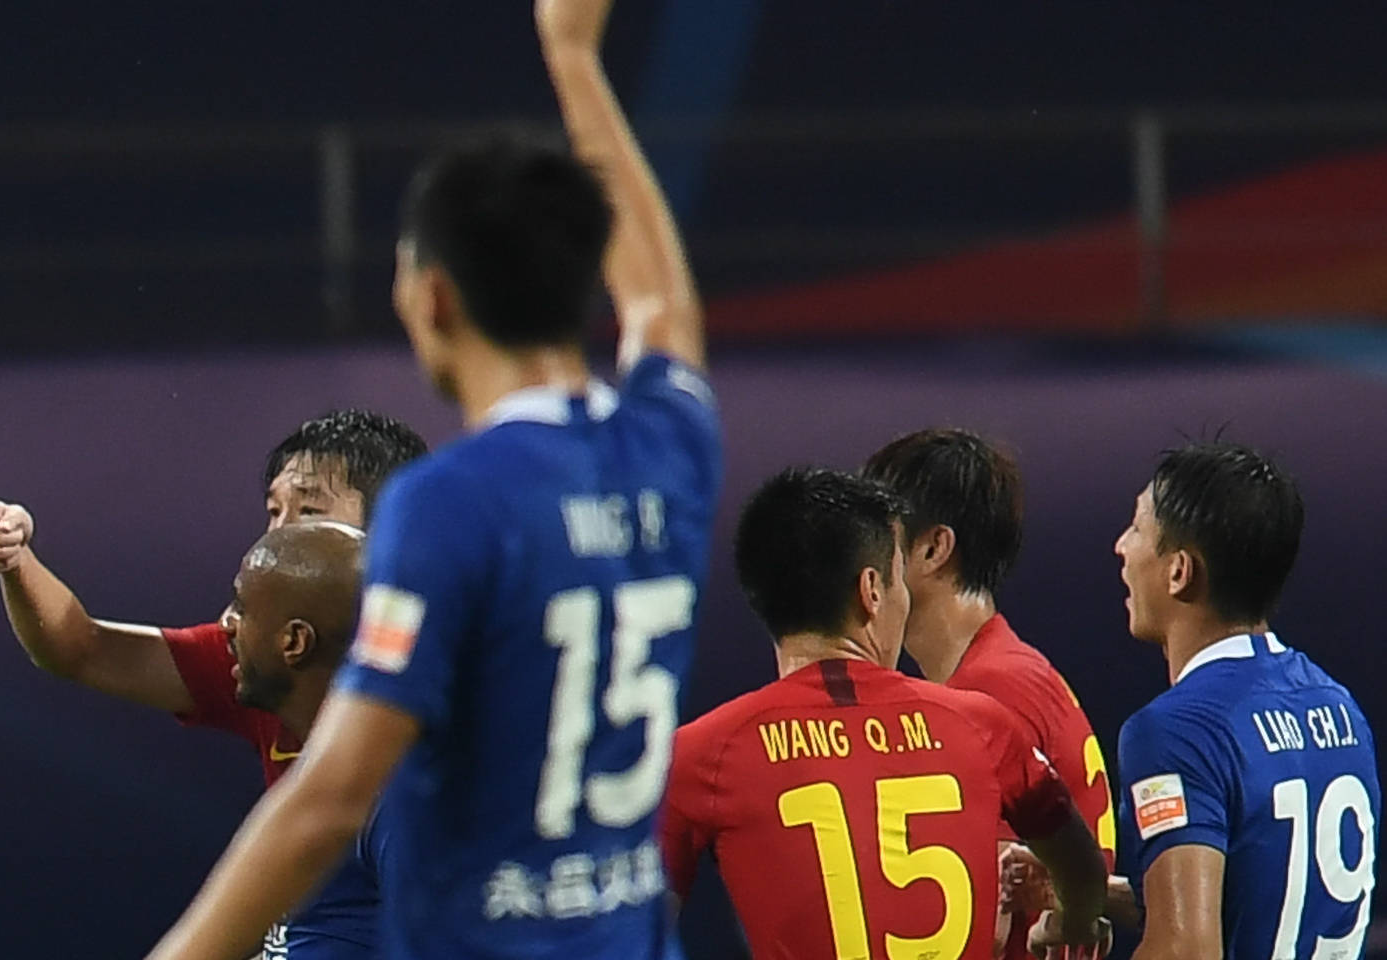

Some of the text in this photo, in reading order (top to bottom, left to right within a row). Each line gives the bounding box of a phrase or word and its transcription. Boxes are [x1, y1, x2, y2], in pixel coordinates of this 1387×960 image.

[535, 574, 697, 841] 15
[1252, 709, 1305, 753] LIAO
[758, 711, 943, 763] WANG Q.M.
